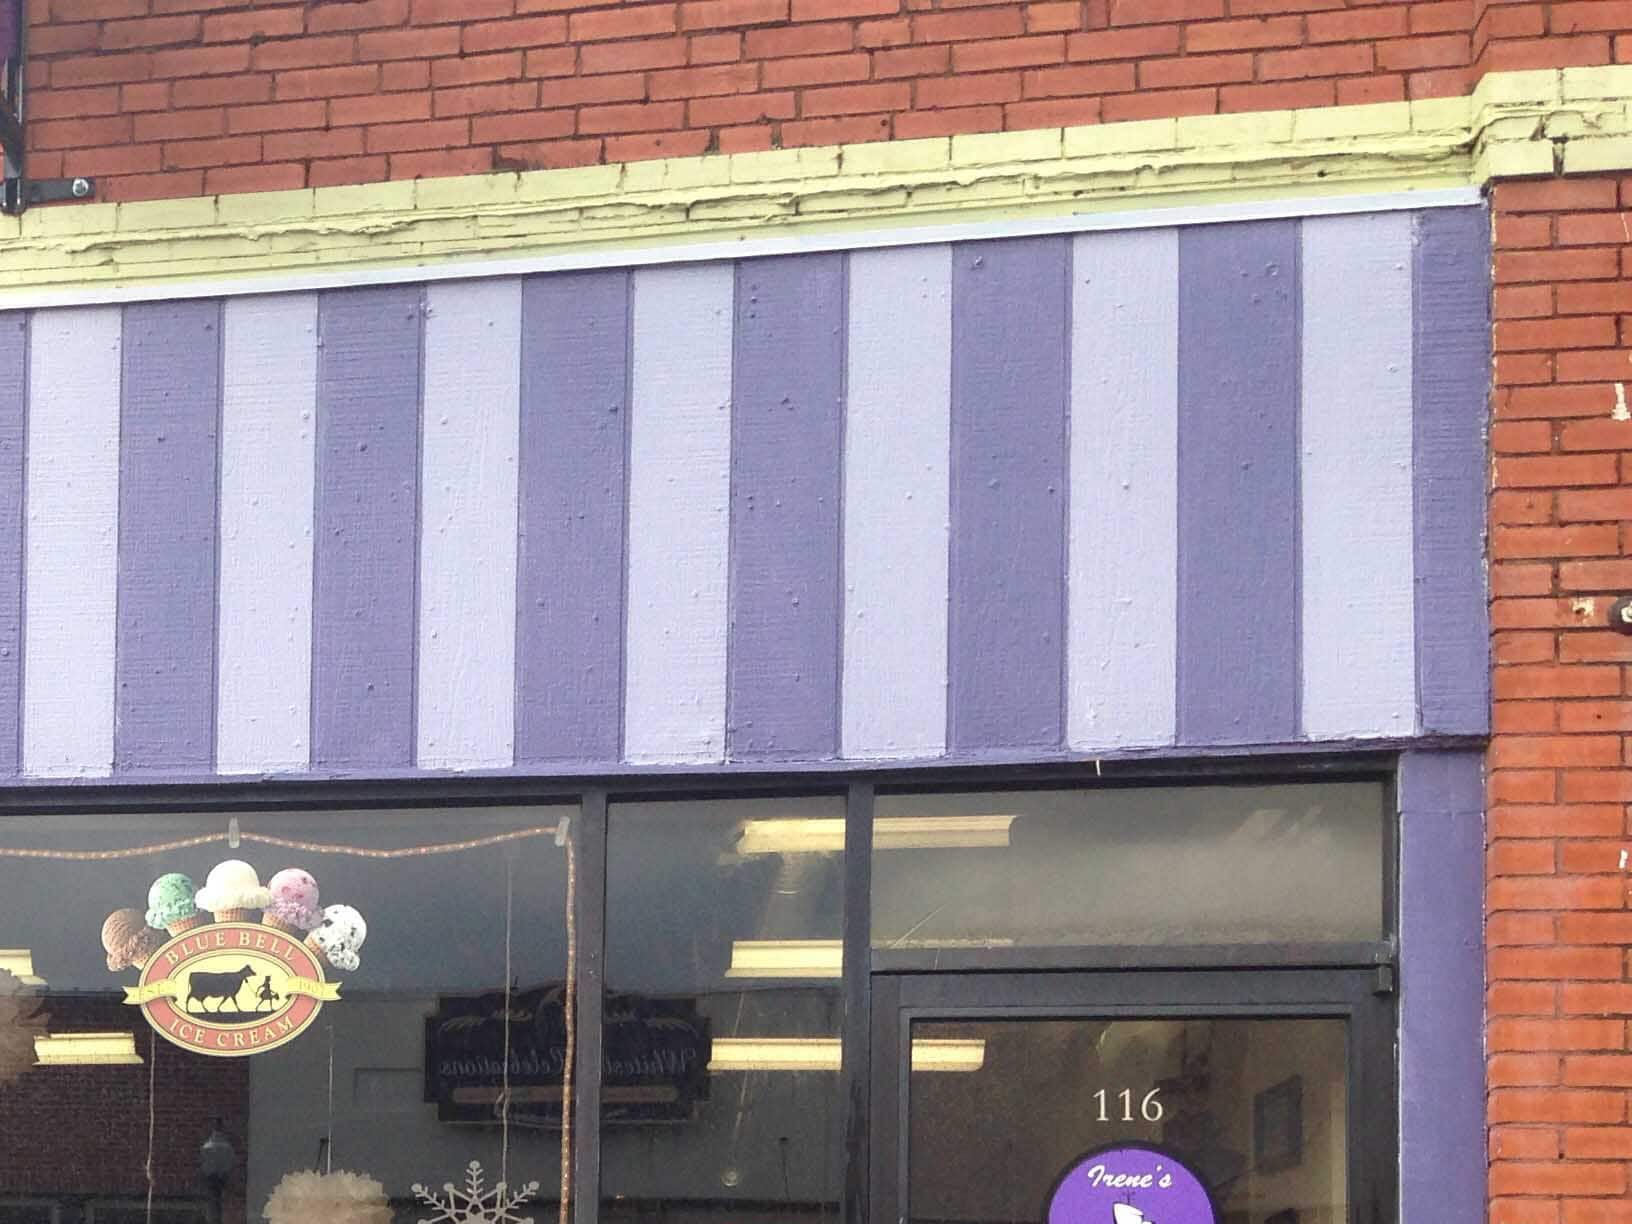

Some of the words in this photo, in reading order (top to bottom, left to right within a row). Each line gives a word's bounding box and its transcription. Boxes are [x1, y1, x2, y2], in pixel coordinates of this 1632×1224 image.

[165, 931, 226, 966] BLUE
[239, 931, 296, 961] BELL
[169, 1018, 205, 1044] ICE
[217, 1015, 295, 1048] CREAM
[1093, 1087, 1164, 1122] 116
[1087, 1164, 1173, 1189] Irene's
